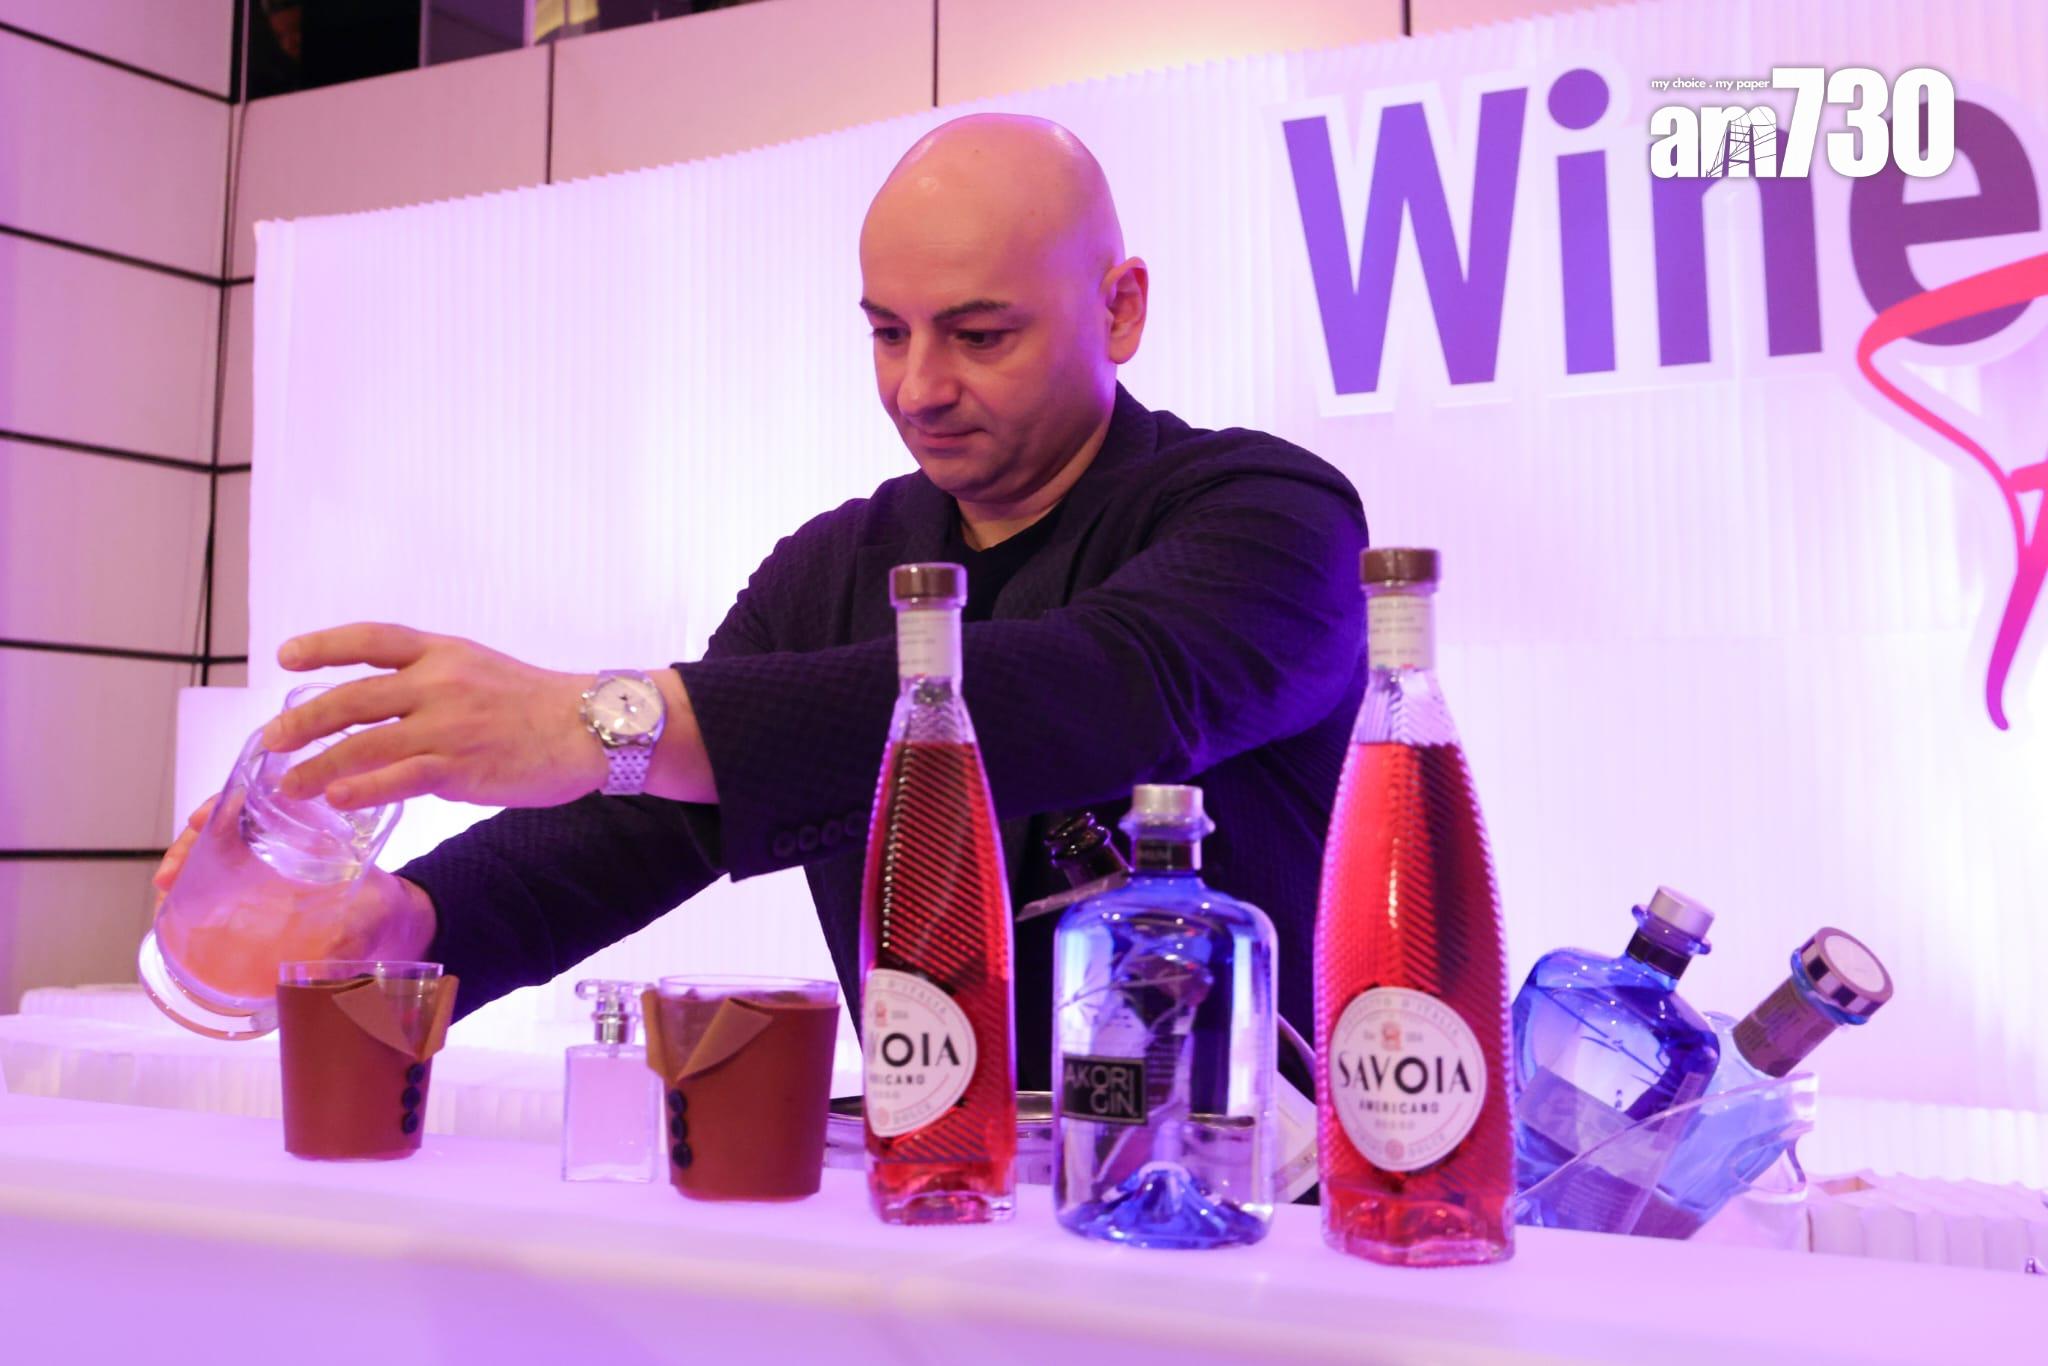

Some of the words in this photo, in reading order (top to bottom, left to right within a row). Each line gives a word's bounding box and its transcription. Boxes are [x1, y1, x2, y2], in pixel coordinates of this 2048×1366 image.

[1282, 67, 2041, 396] Wine
[1338, 1051, 1472, 1094] SAVOIA
[1090, 1087, 1136, 1116] GIN
[1358, 1100, 1440, 1115] AMERICANO
